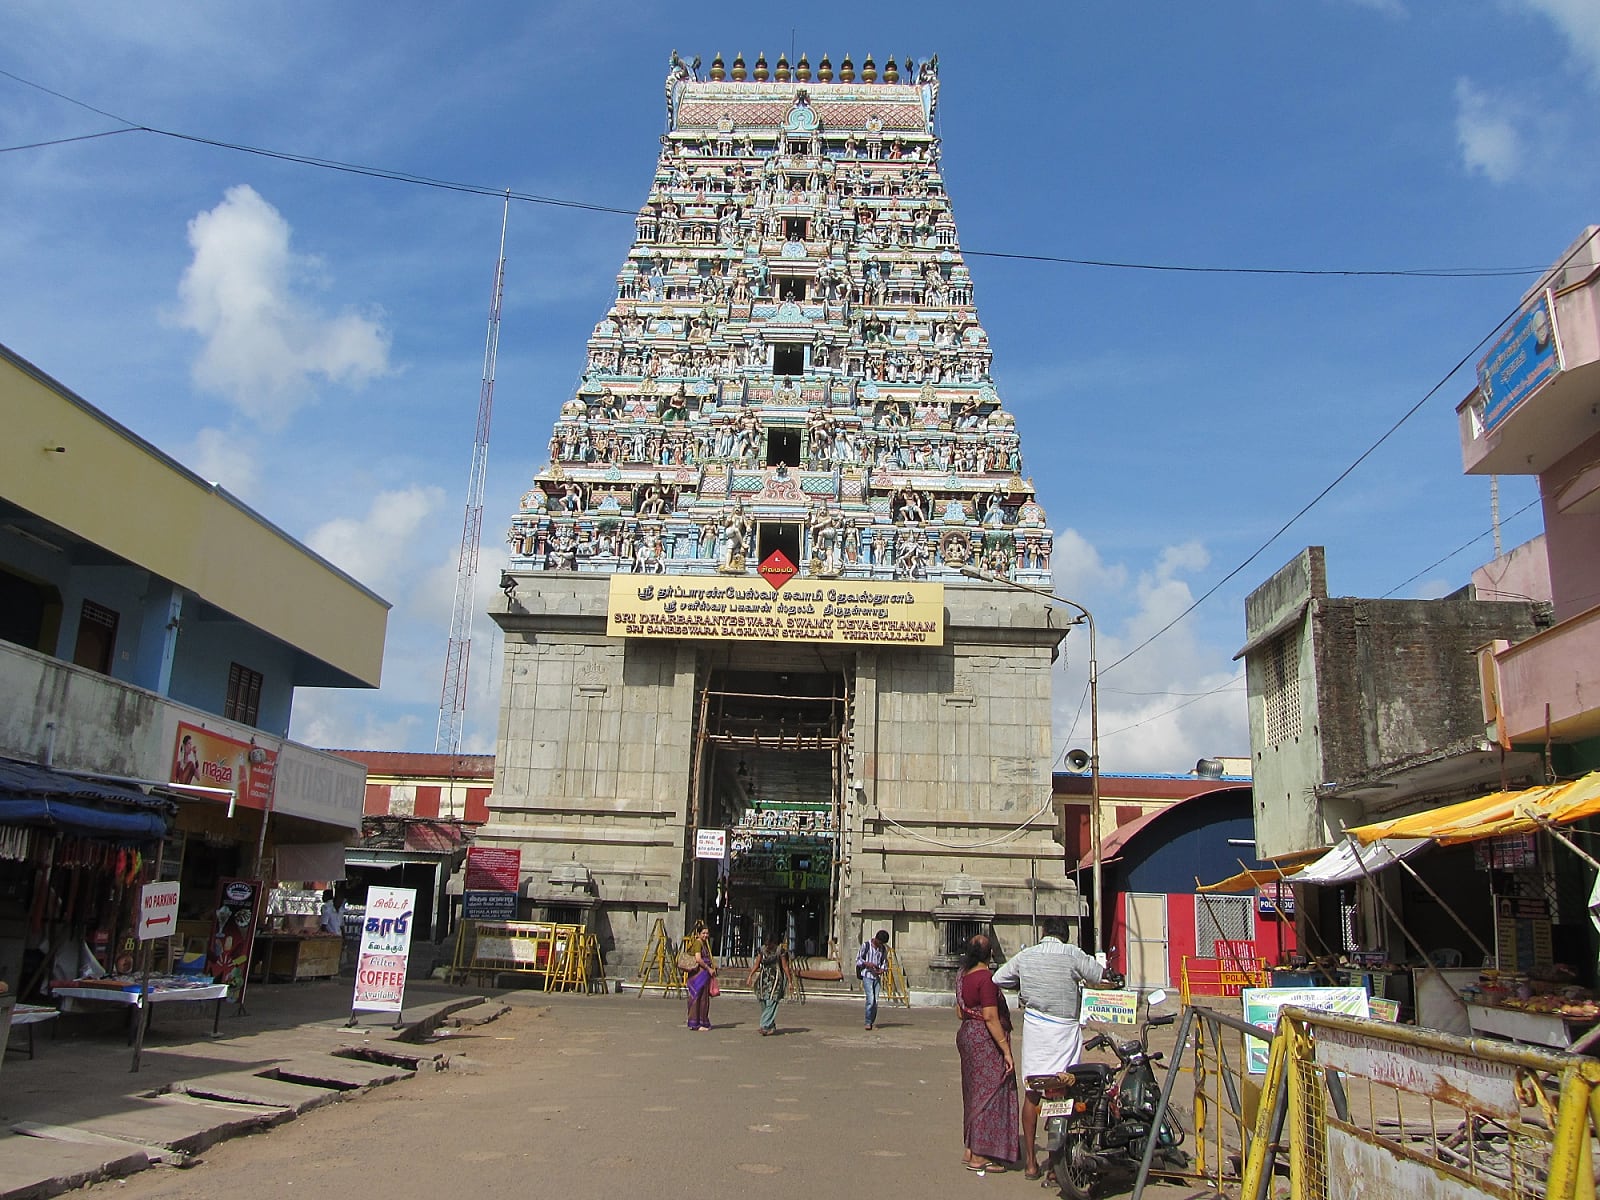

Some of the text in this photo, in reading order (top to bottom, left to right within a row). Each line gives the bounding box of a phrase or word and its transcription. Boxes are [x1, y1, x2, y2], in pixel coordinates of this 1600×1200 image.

[783, 589, 824, 601] சுவாமி
[827, 590, 915, 607] தேவஸ்தானம்
[614, 613, 937, 632] SRI DHARBARANYESWARA SWAMY DEVASTHANAM
[626, 625, 644, 634] SRI
[721, 626, 780, 638] BAGHAVAN
[782, 629, 834, 640] STHALAM
[842, 630, 926, 642] THIRUNALLARU
[202, 761, 233, 783] maaza
[145, 893, 177, 909] NO PARKING
[374, 897, 409, 909] பில்டர்
[365, 911, 413, 936] காபி
[368, 942, 404, 953] கிடைக்கும்
[369, 957, 397, 967] Filter
[360, 970, 404, 988] COFFEE
[363, 990, 398, 1000] Available
[1088, 1005, 1134, 1015] CLOAK ROOM
